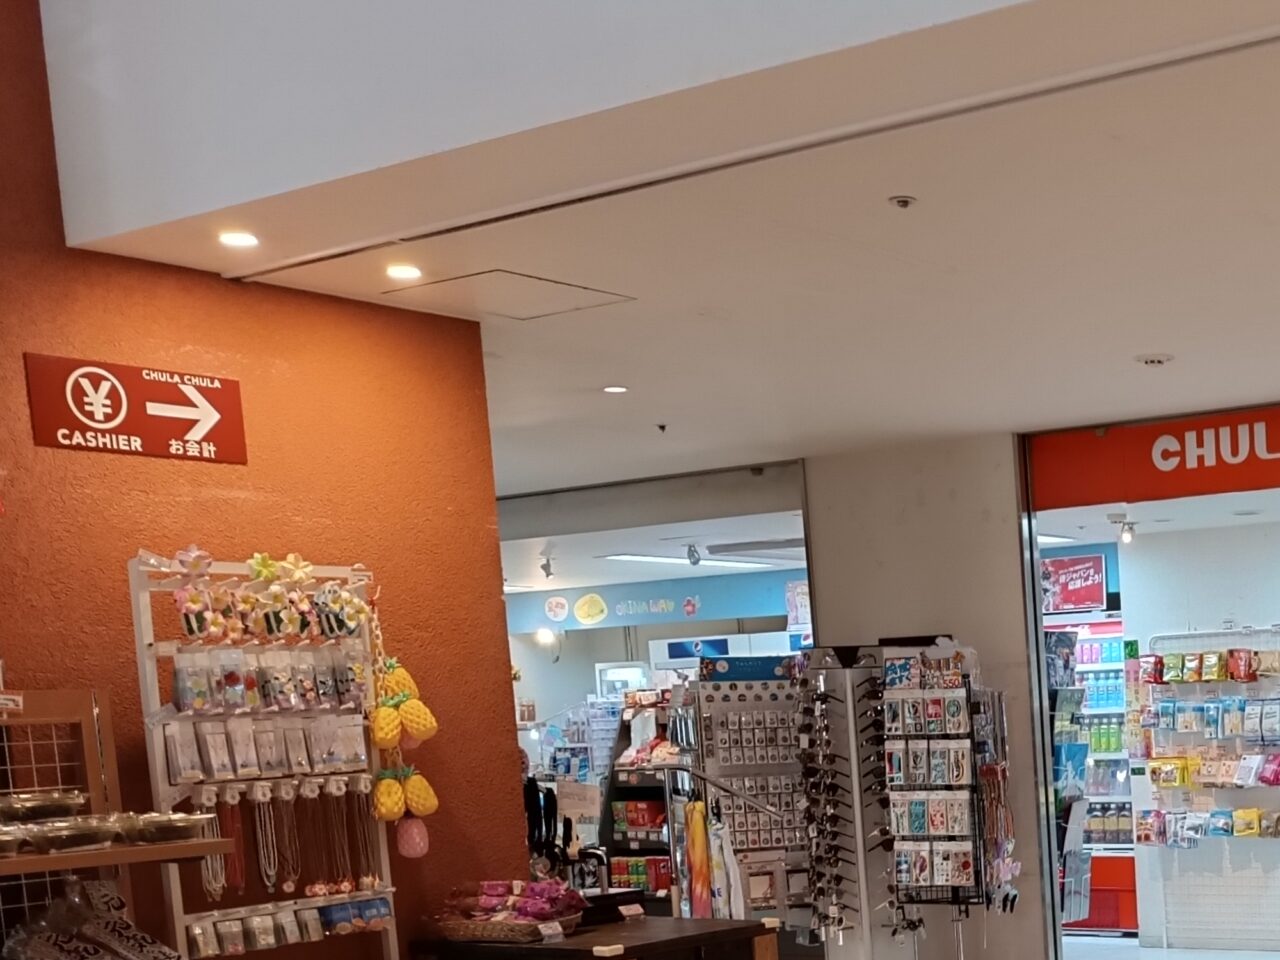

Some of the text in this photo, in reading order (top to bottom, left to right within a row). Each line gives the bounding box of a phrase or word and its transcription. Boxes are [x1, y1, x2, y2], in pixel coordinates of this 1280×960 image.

[142, 369, 222, 389] CHULA CHULA
[56, 427, 143, 452] CASHIER
[168, 438, 218, 459] お会計
[943, 678, 960, 688] 550
